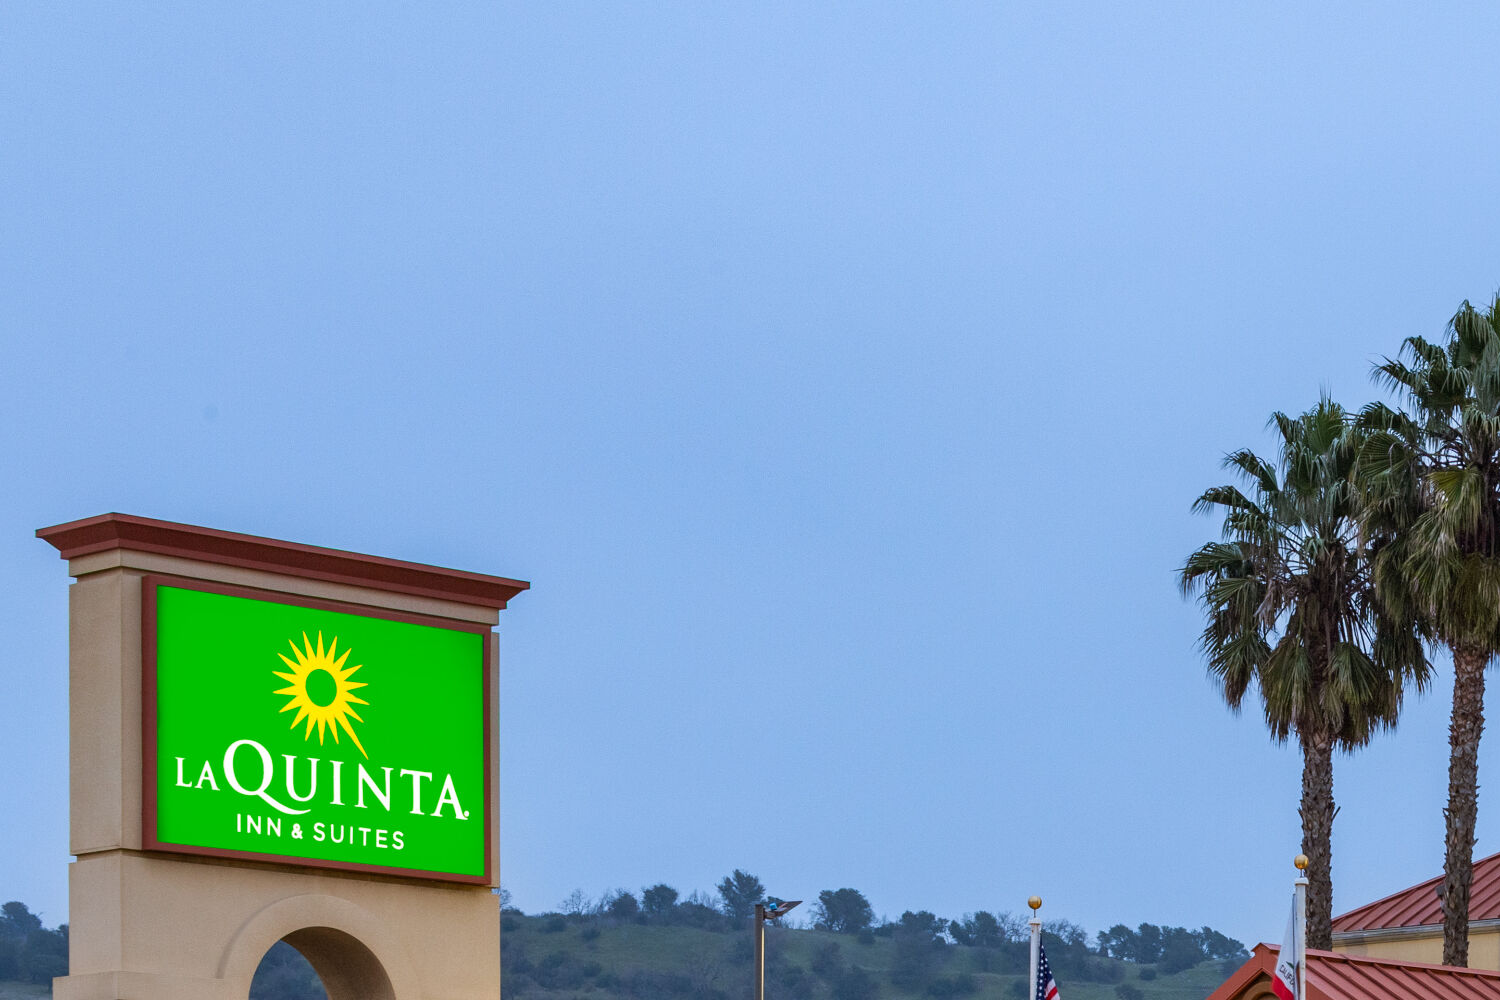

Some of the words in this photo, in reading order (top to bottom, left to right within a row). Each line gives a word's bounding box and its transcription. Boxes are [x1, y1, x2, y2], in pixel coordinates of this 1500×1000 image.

[175, 756, 221, 791] LA
[222, 739, 468, 821] QUINTA
[236, 813, 282, 838] INN
[291, 823, 304, 840] &
[312, 822, 405, 851] SUITES
